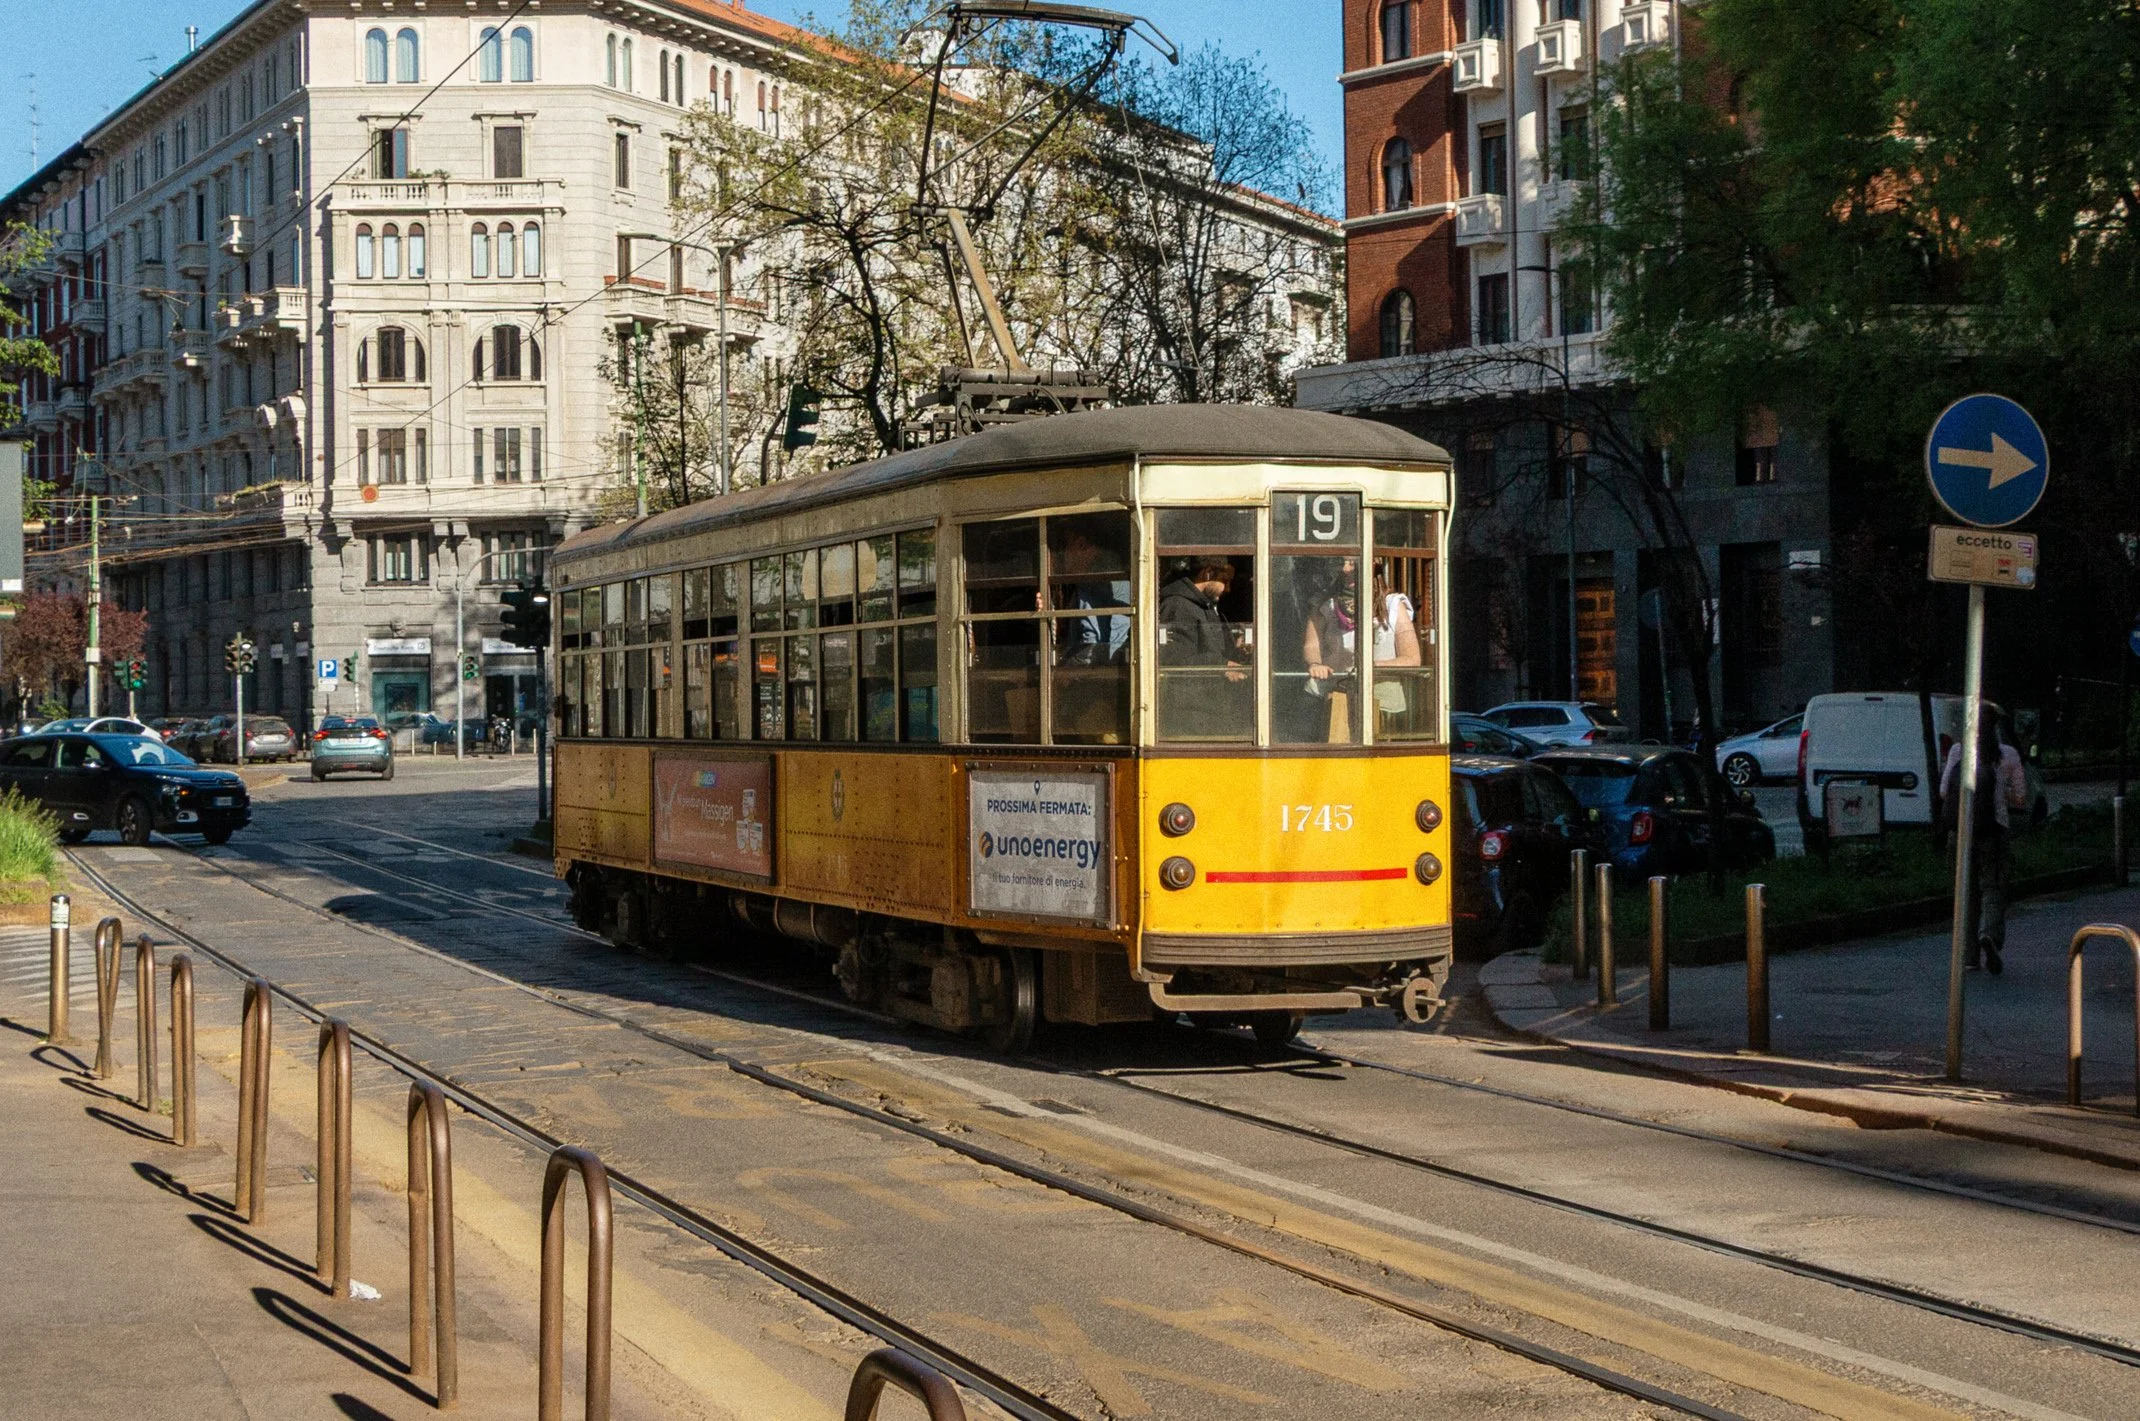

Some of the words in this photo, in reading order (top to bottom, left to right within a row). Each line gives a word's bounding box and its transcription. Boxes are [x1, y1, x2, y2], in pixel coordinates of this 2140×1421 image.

[1296, 494, 1341, 541] 19
[1956, 535, 2013, 550] eccetto
[321, 660, 335, 677] P
[987, 799, 1037, 814] PROSSIMA
[1040, 801, 1091, 816] FERMATA:
[1281, 804, 1354, 832] 1745
[997, 836, 1101, 870] unoenergy
[998, 873, 1011, 884] tuo
[1011, 872, 1044, 886] fornitore
[1045, 875, 1054, 887] di
